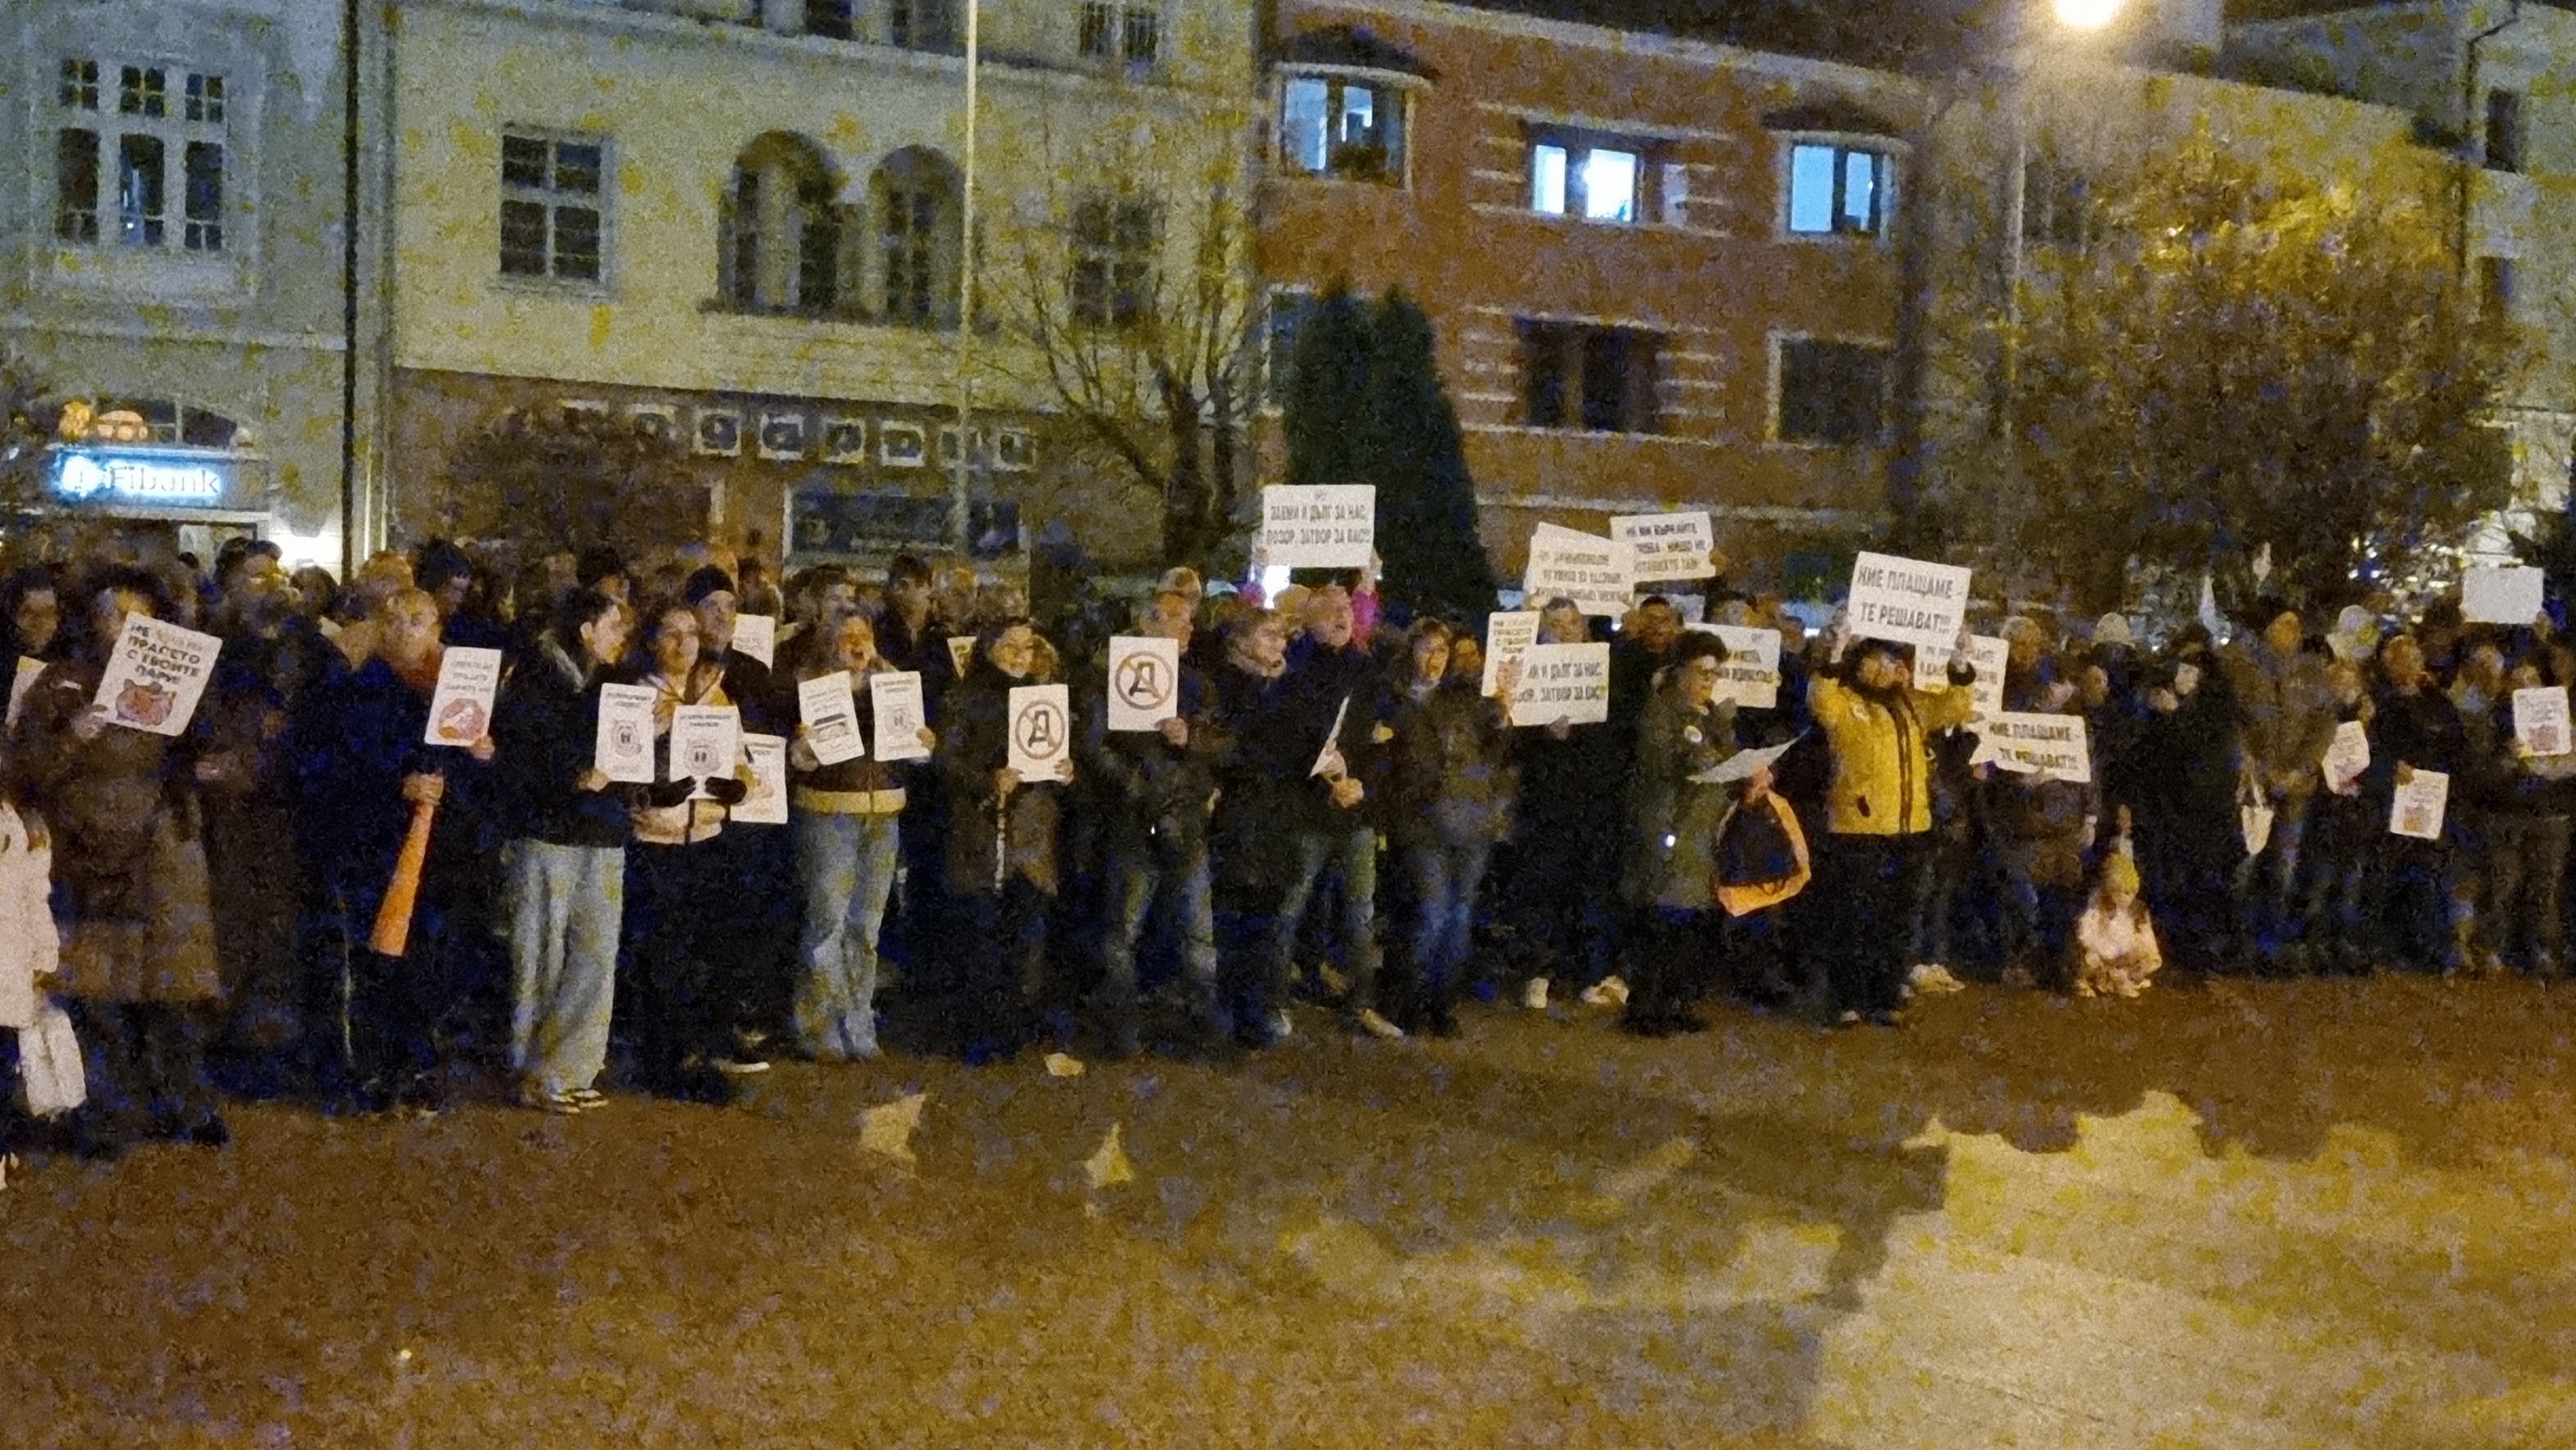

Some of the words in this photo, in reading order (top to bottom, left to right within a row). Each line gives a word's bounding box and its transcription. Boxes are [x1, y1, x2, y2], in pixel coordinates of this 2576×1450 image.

[109, 466, 218, 493] Fibank
[1335, 504, 1345, 520] ЗА
[1334, 529, 1345, 544] ЗА
[1857, 564, 1884, 587] НИЕ
[1887, 570, 1953, 599] ПЛАЩАМЕ
[1861, 601, 1877, 622] ТЕ
[126, 649, 138, 659] С
[128, 634, 200, 664] ПРАСЕТО
[1129, 661, 1160, 697] Д
[1028, 710, 1055, 748] Д
